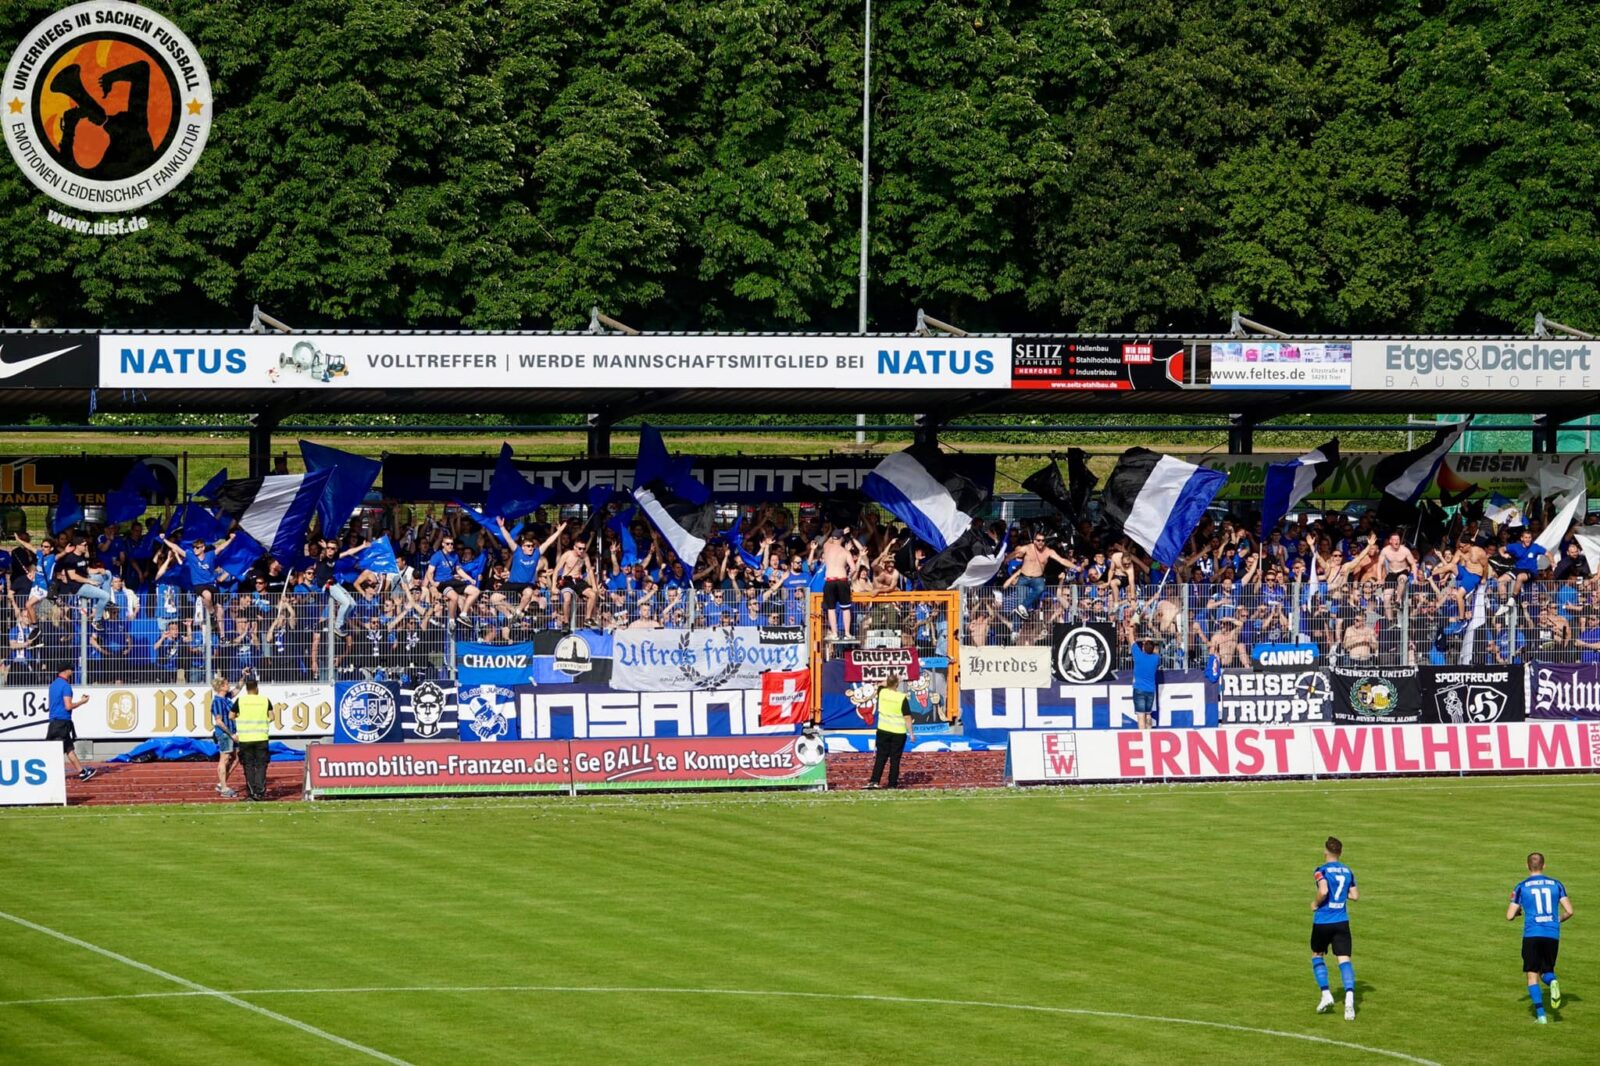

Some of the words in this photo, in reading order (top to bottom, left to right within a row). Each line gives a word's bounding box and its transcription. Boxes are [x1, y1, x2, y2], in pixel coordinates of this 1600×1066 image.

[1015, 344, 1062, 358] SEITZ
[1076, 356, 1121, 364] Stahlhochbau
[1386, 343, 1591, 374] Etges&Dächert
[120, 348, 247, 374] NATUS
[367, 354, 497, 368] VOLLTREFFER
[518, 354, 585, 368] WERDE
[592, 354, 829, 369] MANNSCHAFTSMITGLIED
[836, 355, 864, 369] BEI
[877, 350, 994, 374] NATUS
[1211, 368, 1306, 380] www.feltes.de
[1385, 375, 1590, 387] BAUSTOFFE
[1457, 455, 1529, 472] REISEN
[760, 630, 804, 644] FANATICS
[463, 654, 526, 668] CHAONZ
[852, 650, 912, 663] GRUPPA
[969, 655, 1038, 675] Heredes
[1260, 650, 1314, 666] CANNIS
[1335, 669, 1379, 678] SCHWEICH
[1382, 669, 1415, 678] UNITED
[1435, 672, 1509, 683] SPORTFREUNDE
[1223, 674, 1297, 697] REISE
[23, 692, 49, 717] Bi
[152, 688, 332, 733] Bitrge
[1224, 699, 1323, 723] TRUPPE
[1046, 735, 1059, 754] E
[1117, 729, 1295, 776] ERNST
[1313, 723, 1592, 772] WILHELMI
[318, 752, 558, 778] Immobilien-Franzen.de
[684, 751, 793, 775] Kompetenz
[1050, 755, 1075, 775] W
[1335, 875, 1345, 900] 7
[1531, 888, 1552, 914] 11
